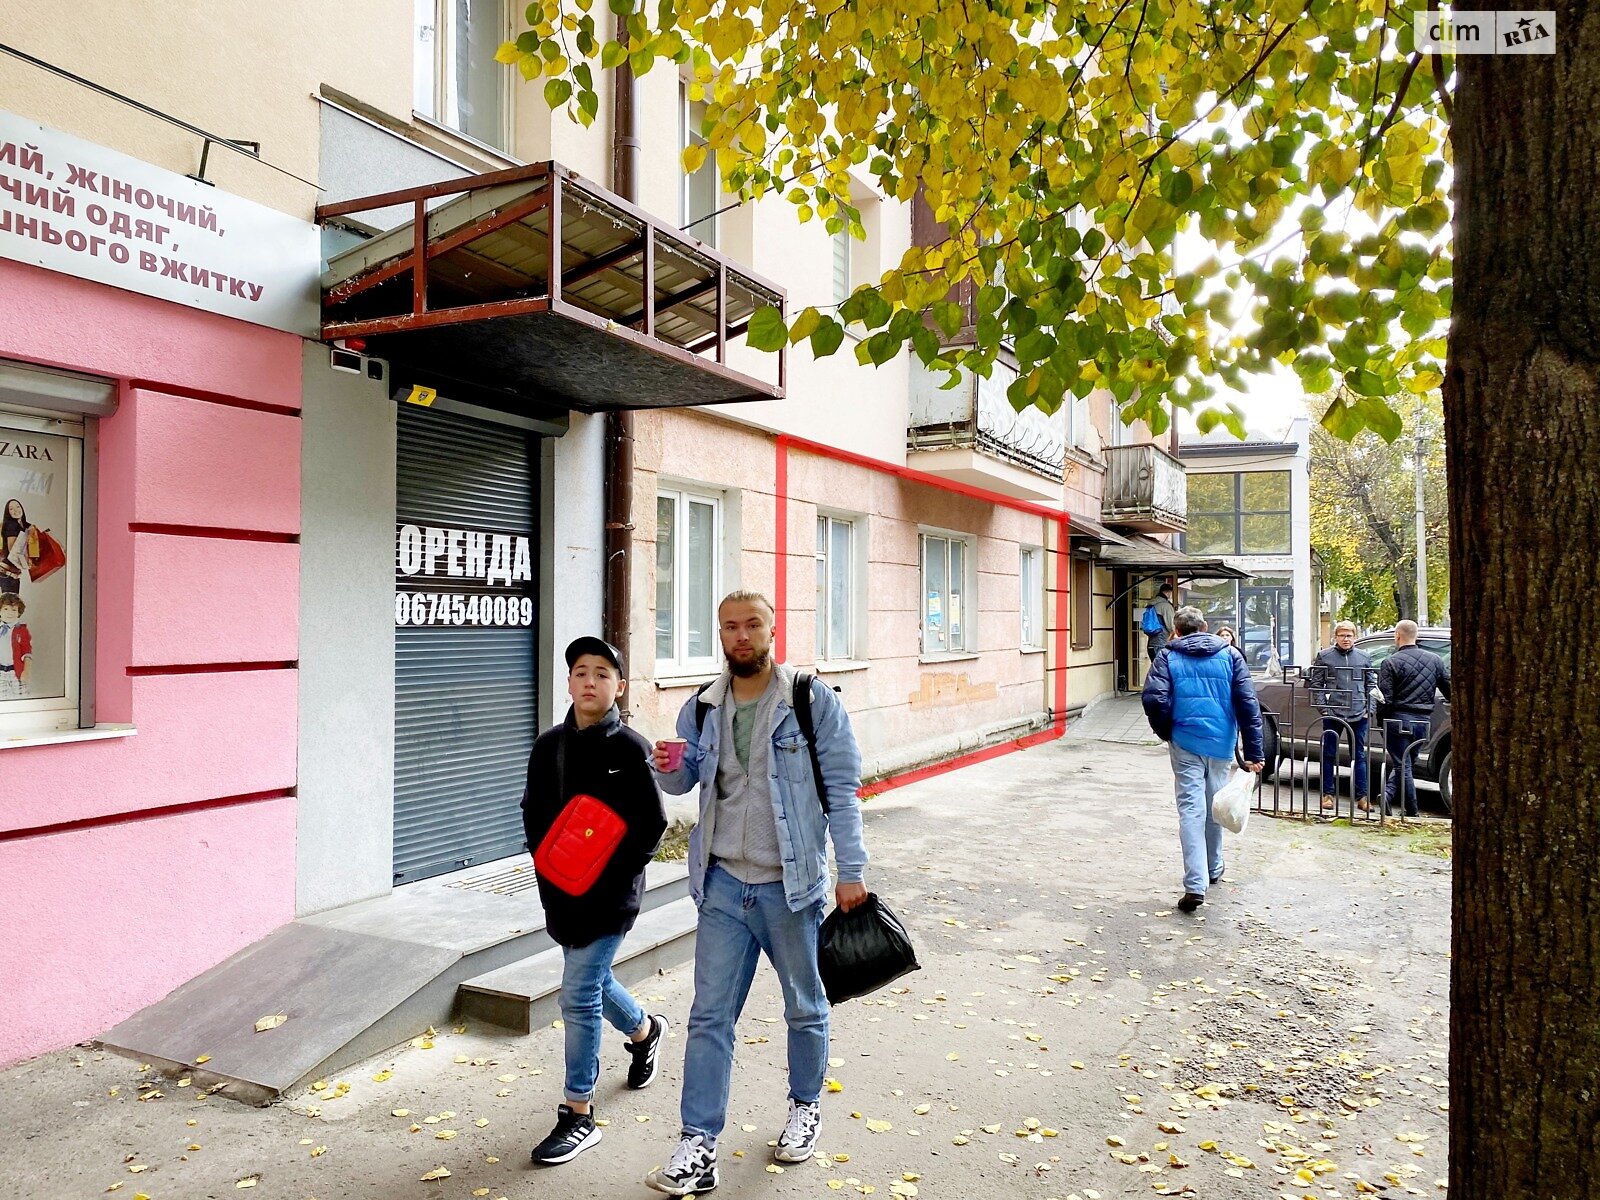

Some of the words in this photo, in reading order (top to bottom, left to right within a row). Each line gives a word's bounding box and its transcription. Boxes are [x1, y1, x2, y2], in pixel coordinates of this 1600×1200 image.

[65, 162, 225, 238] ЖІНОЧИЙ,
[86, 203, 179, 252] ОДЯГ,
[139, 250, 264, 302] ВЖИТКУ
[0, 441, 54, 462] ZARA
[399, 524, 532, 587] ОРЕНДА
[395, 592, 533, 626] 0674540089
